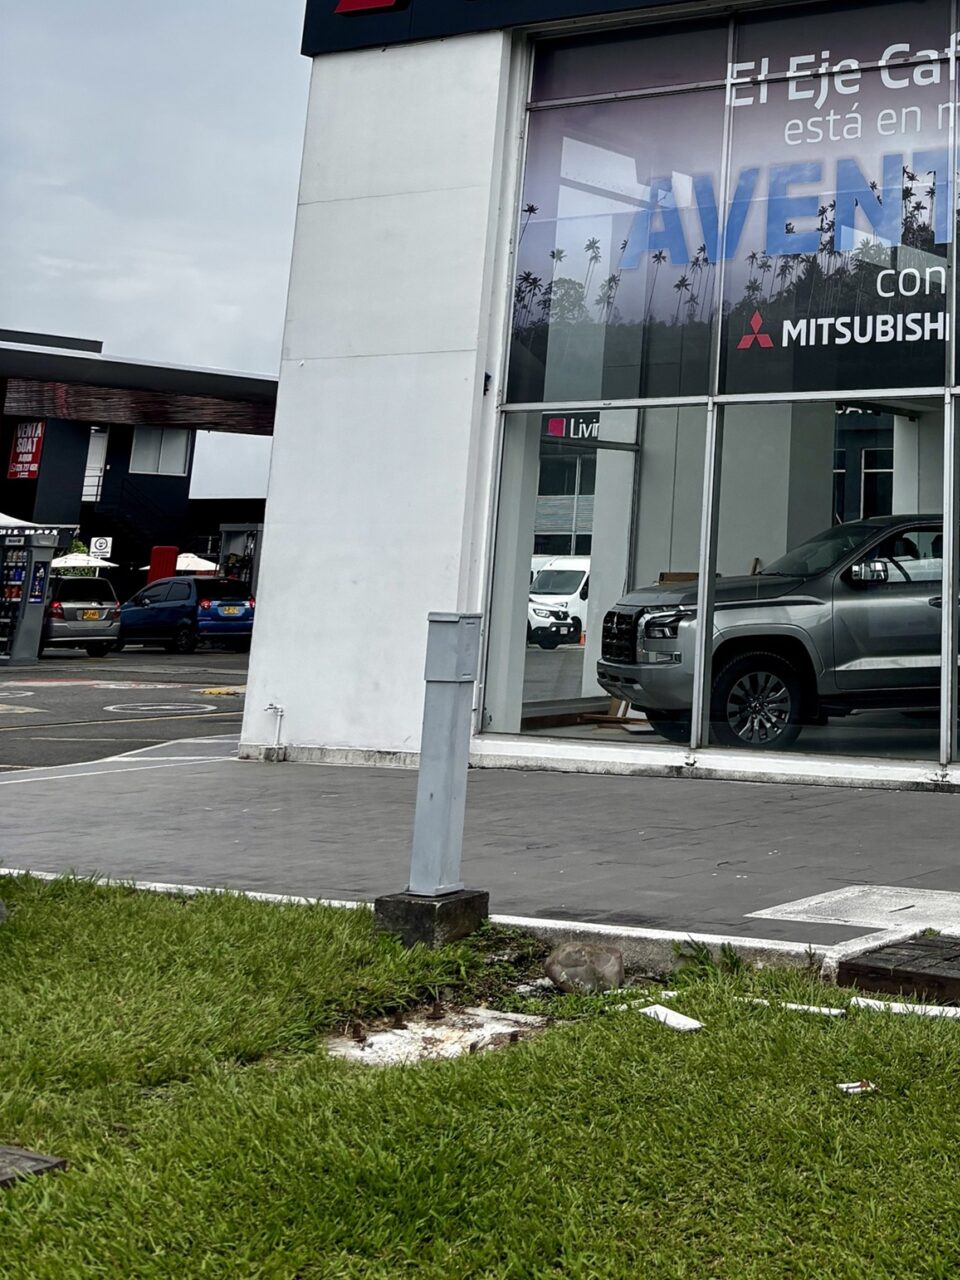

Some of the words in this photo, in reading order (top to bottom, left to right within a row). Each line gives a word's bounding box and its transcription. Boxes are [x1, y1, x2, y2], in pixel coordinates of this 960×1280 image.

[726, 57, 769, 107] El
[786, 50, 862, 110] Eje
[784, 102, 863, 145] está
[876, 103, 921, 136] en
[876, 264, 946, 298] con
[782, 311, 950, 347] MITSUBISHI
[16, 437, 39, 453] SOAT
[17, 422, 43, 438] VENTA
